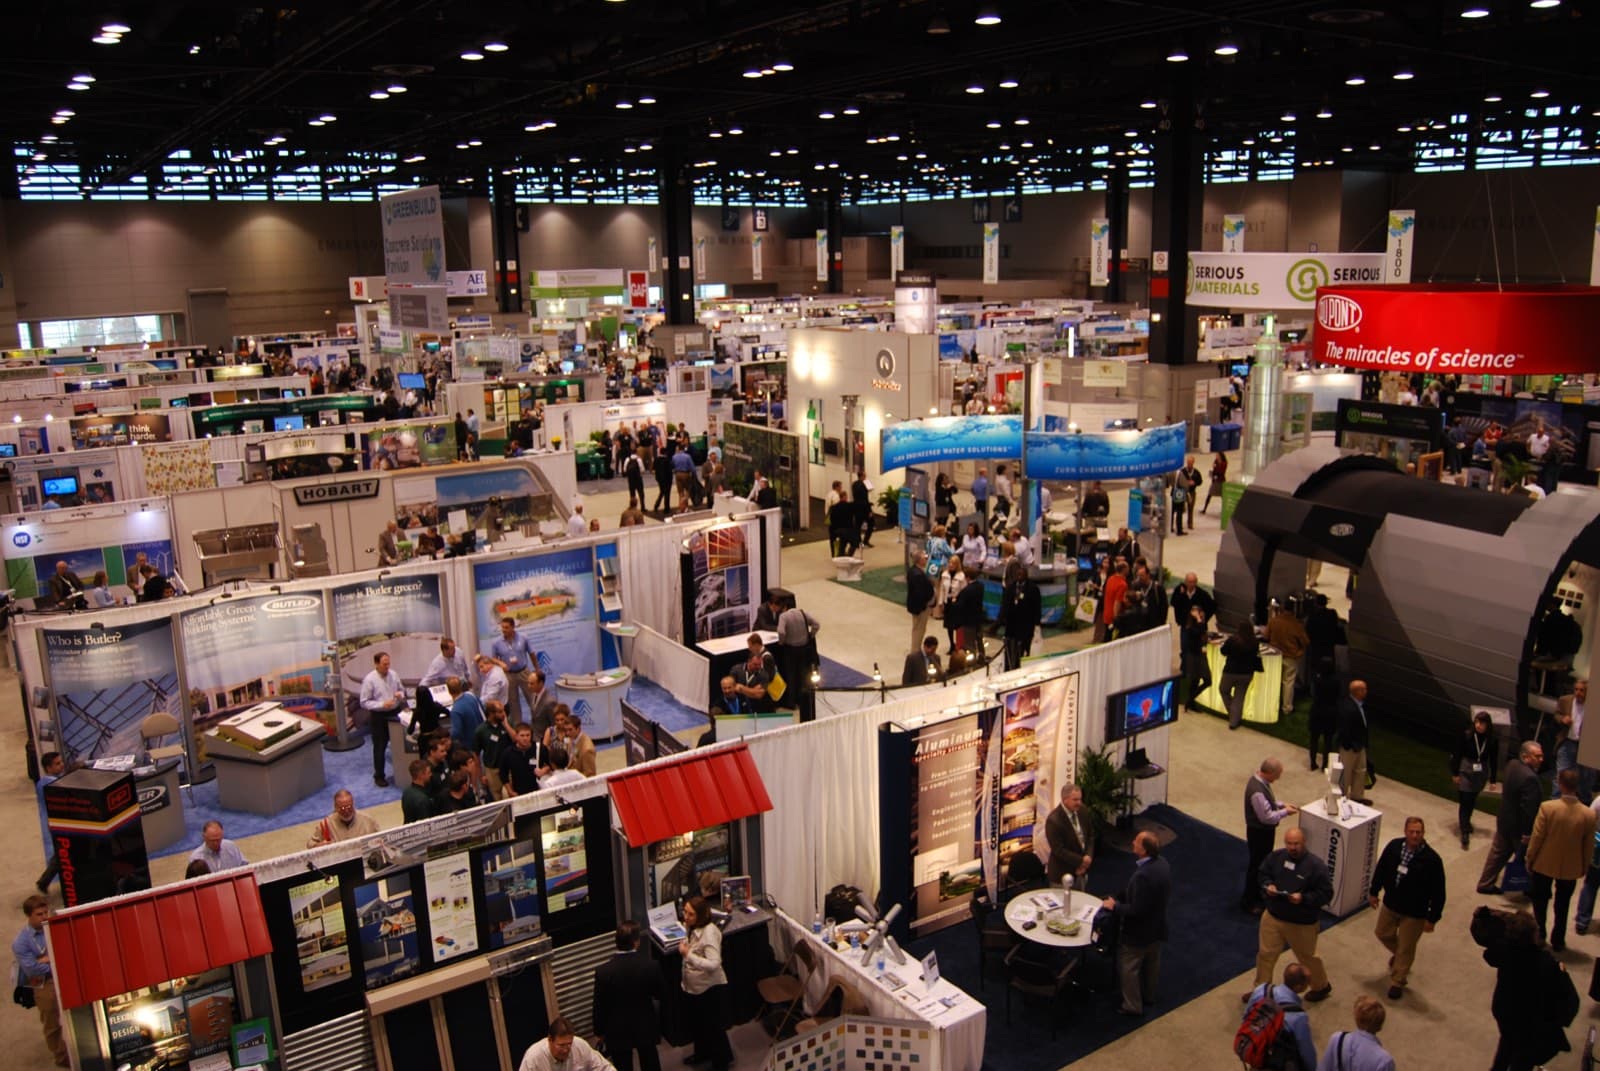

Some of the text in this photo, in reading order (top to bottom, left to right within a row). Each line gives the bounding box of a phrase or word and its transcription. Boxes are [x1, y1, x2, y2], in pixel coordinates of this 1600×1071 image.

[1195, 267, 1244, 280] SERIOUS
[1333, 268, 1380, 281] SERIOUS
[1195, 283, 1260, 296] MATERIALS
[1326, 341, 1343, 360] The
[1345, 346, 1411, 366] miracles
[1415, 347, 1439, 370] of
[129, 424, 151, 433] think
[943, 447, 965, 457] WATER
[1079, 464, 1127, 473] ENGINEERED
[1129, 463, 1150, 471] WATER
[303, 482, 372, 499] HOBART
[480, 570, 526, 584] INSULATED
[527, 566, 553, 578] METAL
[556, 560, 585, 573] PANELS
[356, 588, 365, 599] is
[365, 585, 392, 597] Butler
[393, 580, 422, 595] green?
[226, 605, 257, 616] Green
[272, 599, 312, 609] BUTLER
[47, 632, 122, 646] Who is Butler?
[1065, 689, 1076, 755] creatively
[915, 729, 983, 756] Aluminum
[950, 787, 973, 801] Design
[932, 801, 972, 817] Engineering
[990, 773, 1000, 850] CONSERVATEK
[933, 811, 972, 827] Fabrication
[404, 824, 429, 839] Single
[430, 817, 458, 831] Source
[1327, 828, 1341, 882] CONSERV
[112, 1026, 140, 1040] DESIGN
